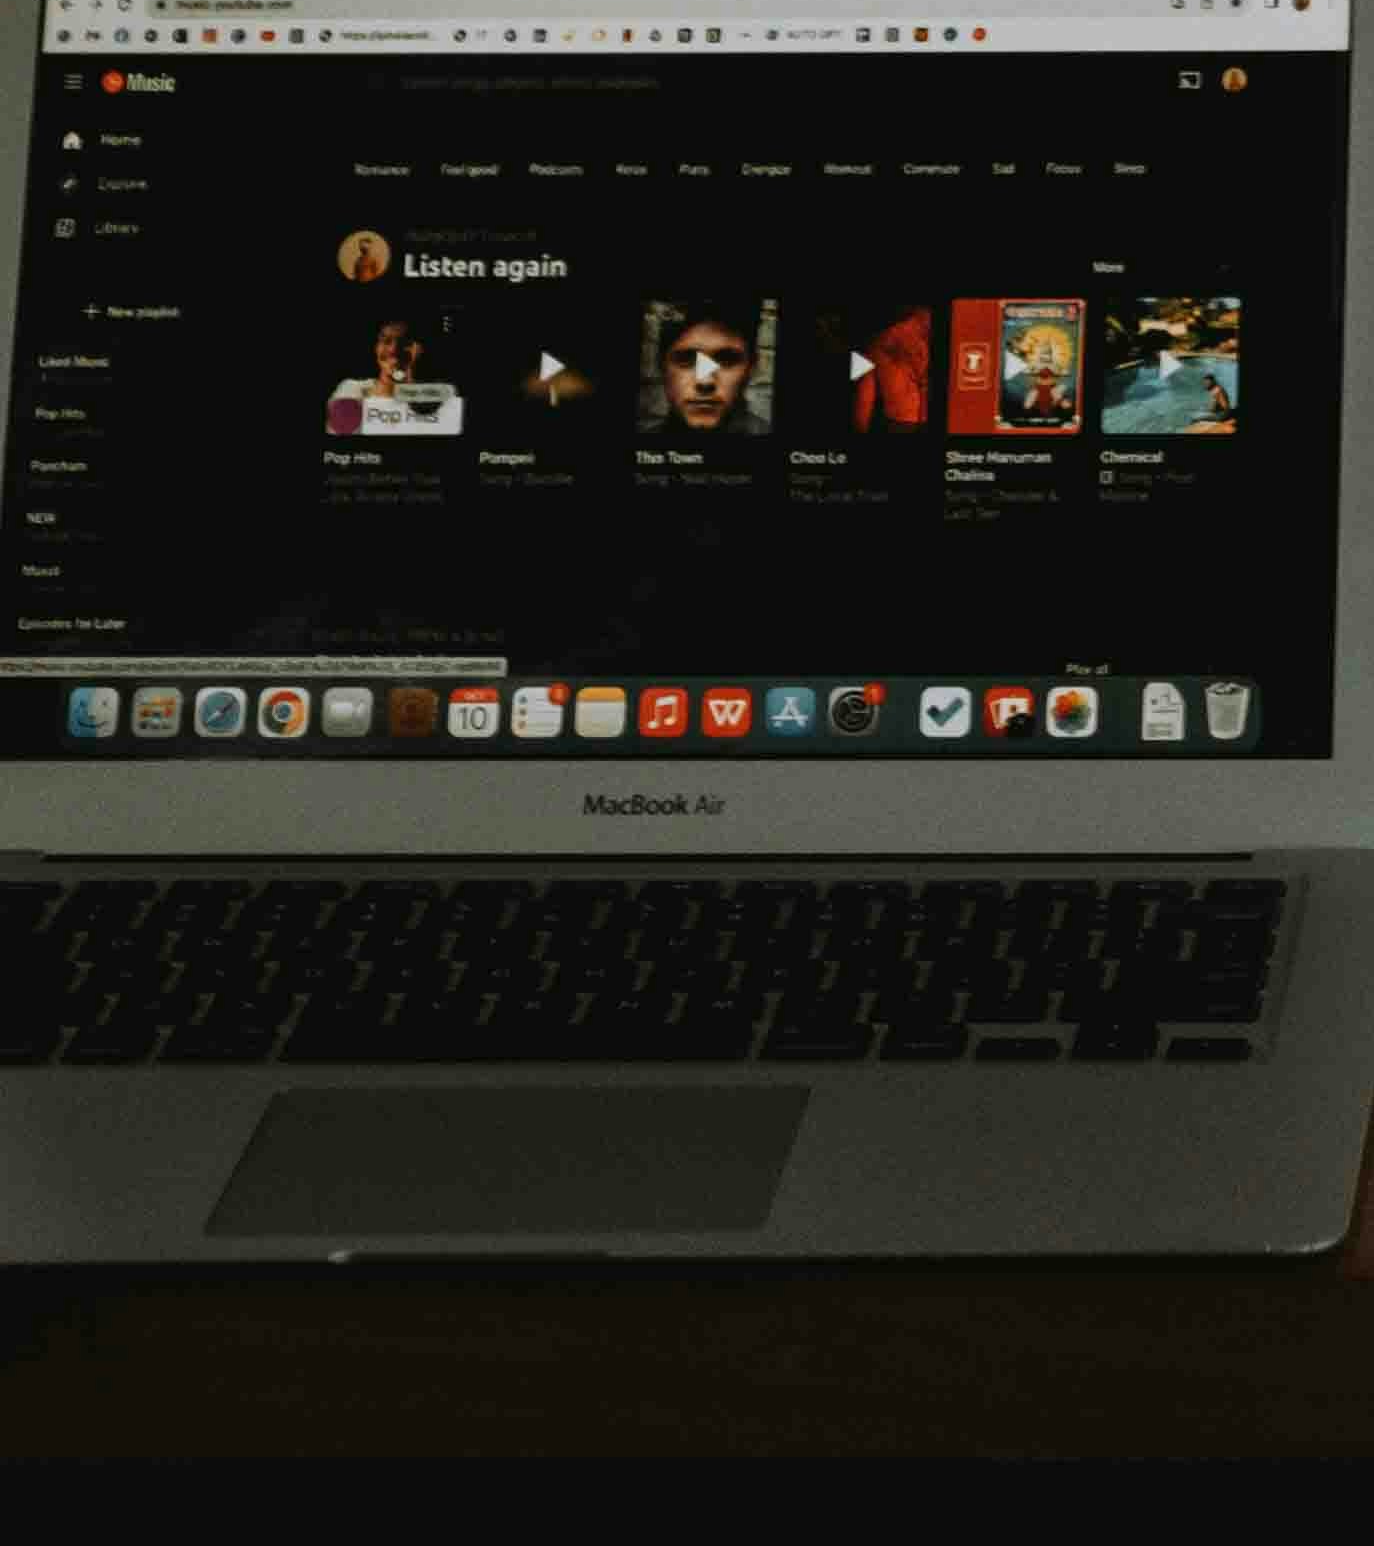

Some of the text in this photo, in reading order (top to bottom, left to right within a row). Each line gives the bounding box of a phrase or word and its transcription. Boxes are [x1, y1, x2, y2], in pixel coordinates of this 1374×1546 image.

[404, 255, 567, 283] Listen again
[457, 705, 486, 730] 10
[583, 793, 726, 816] MacBook Air
